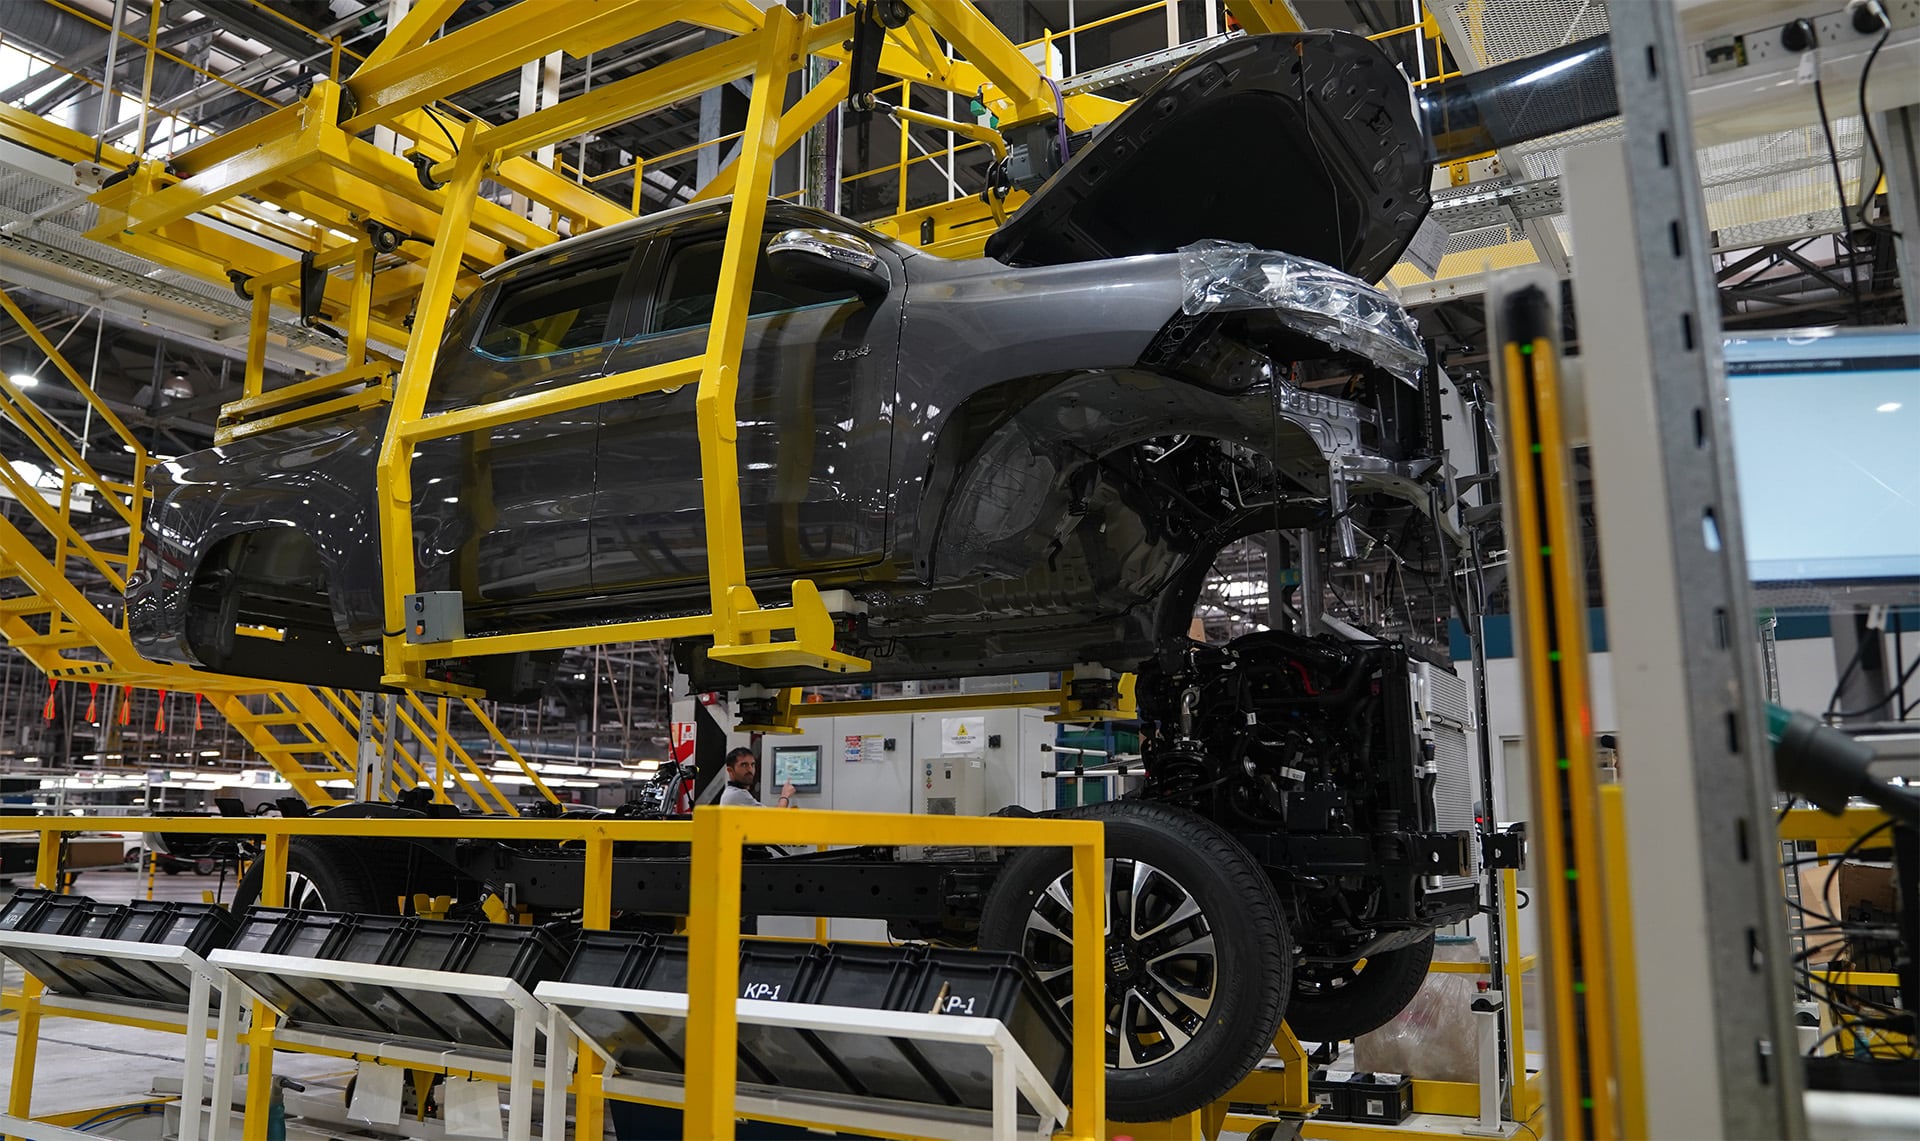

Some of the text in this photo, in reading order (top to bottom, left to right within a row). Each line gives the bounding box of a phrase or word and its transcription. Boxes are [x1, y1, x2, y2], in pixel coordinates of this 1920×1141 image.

[833, 344, 872, 361] 4x4
[1110, 943, 1130, 973] FIAT
[743, 982, 781, 1000] KP-1
